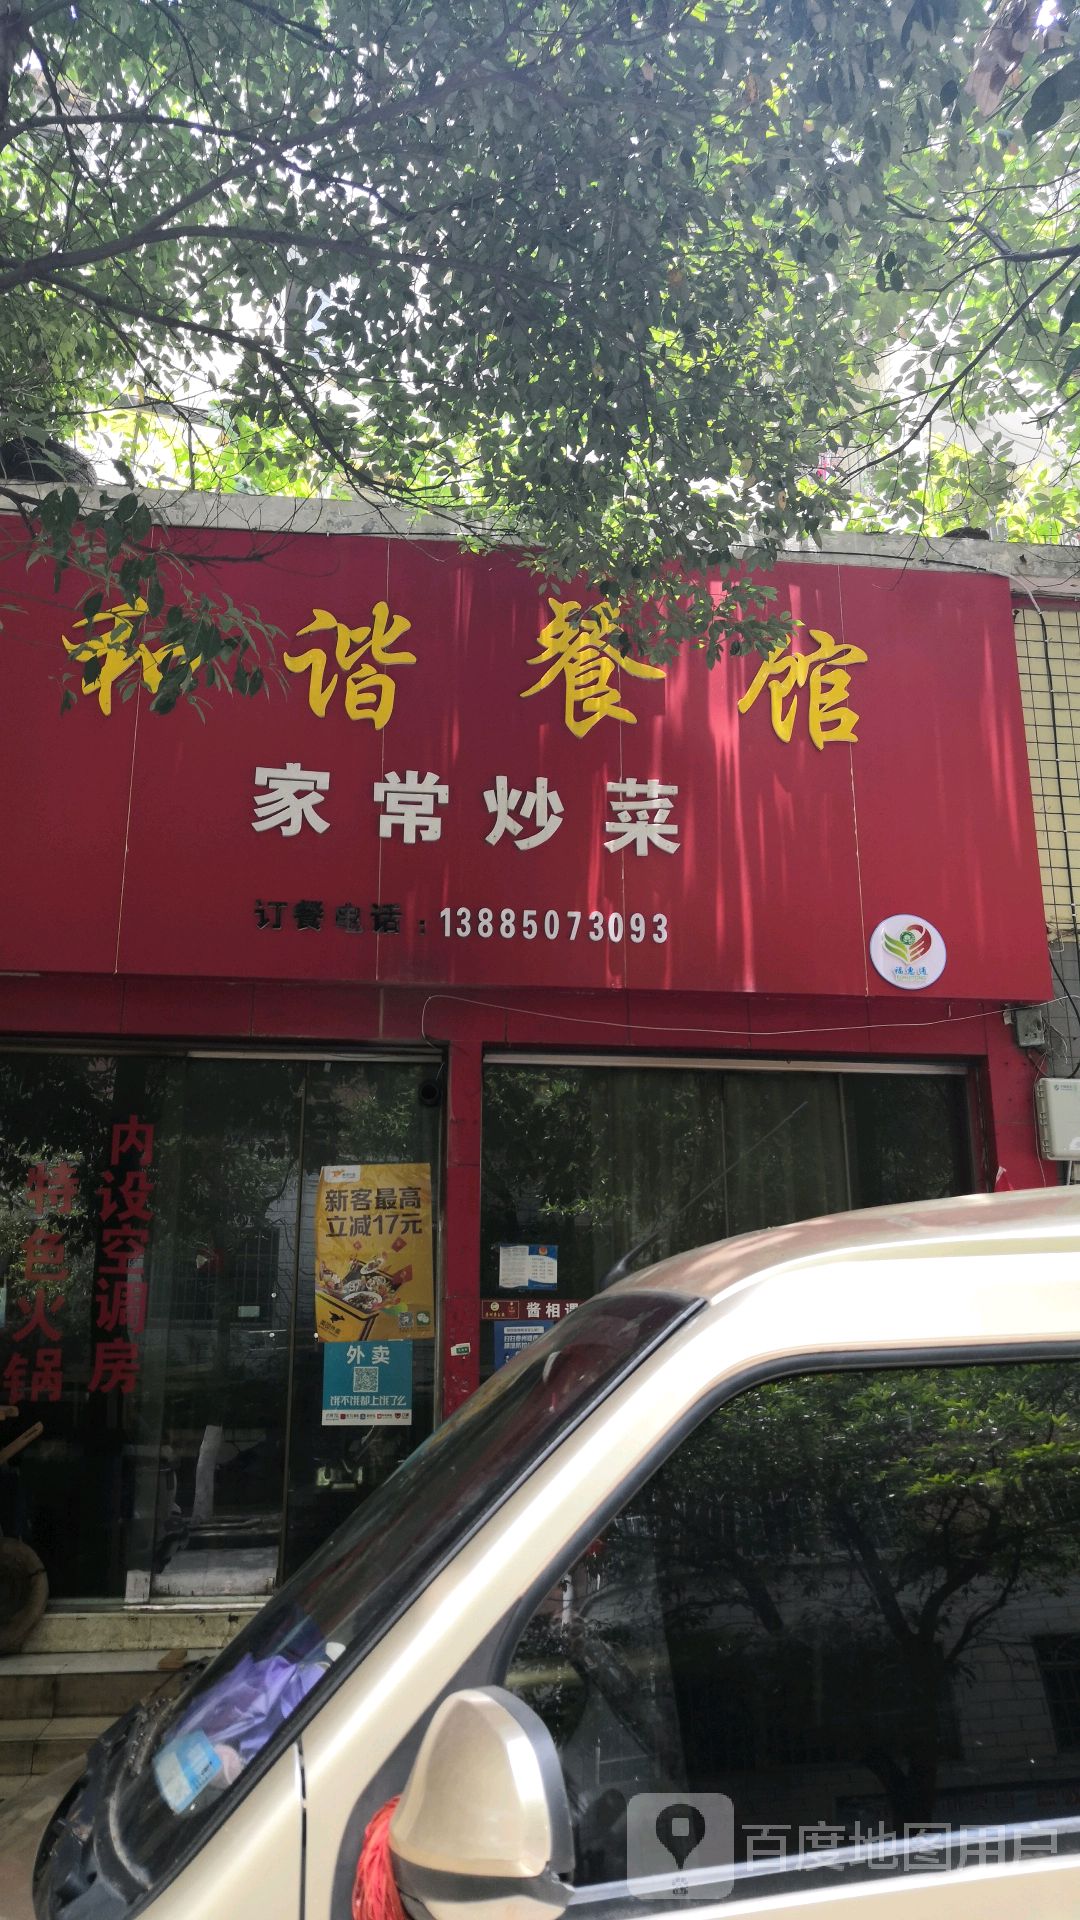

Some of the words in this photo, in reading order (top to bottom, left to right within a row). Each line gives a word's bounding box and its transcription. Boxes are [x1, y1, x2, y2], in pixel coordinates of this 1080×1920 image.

[61, 596, 868, 750] 和谐餐馆
[251, 763, 681, 857] 家常炒菜
[325, 1187, 422, 1212] 新客最高
[325, 1213, 423, 1238] 立减17元
[3, 1161, 80, 1405] 特色火锅
[87, 1114, 155, 1393] 内设空调房
[346, 1345, 390, 1365] 外卖
[330, 1395, 406, 1407] 饿不饿都上饿了么
